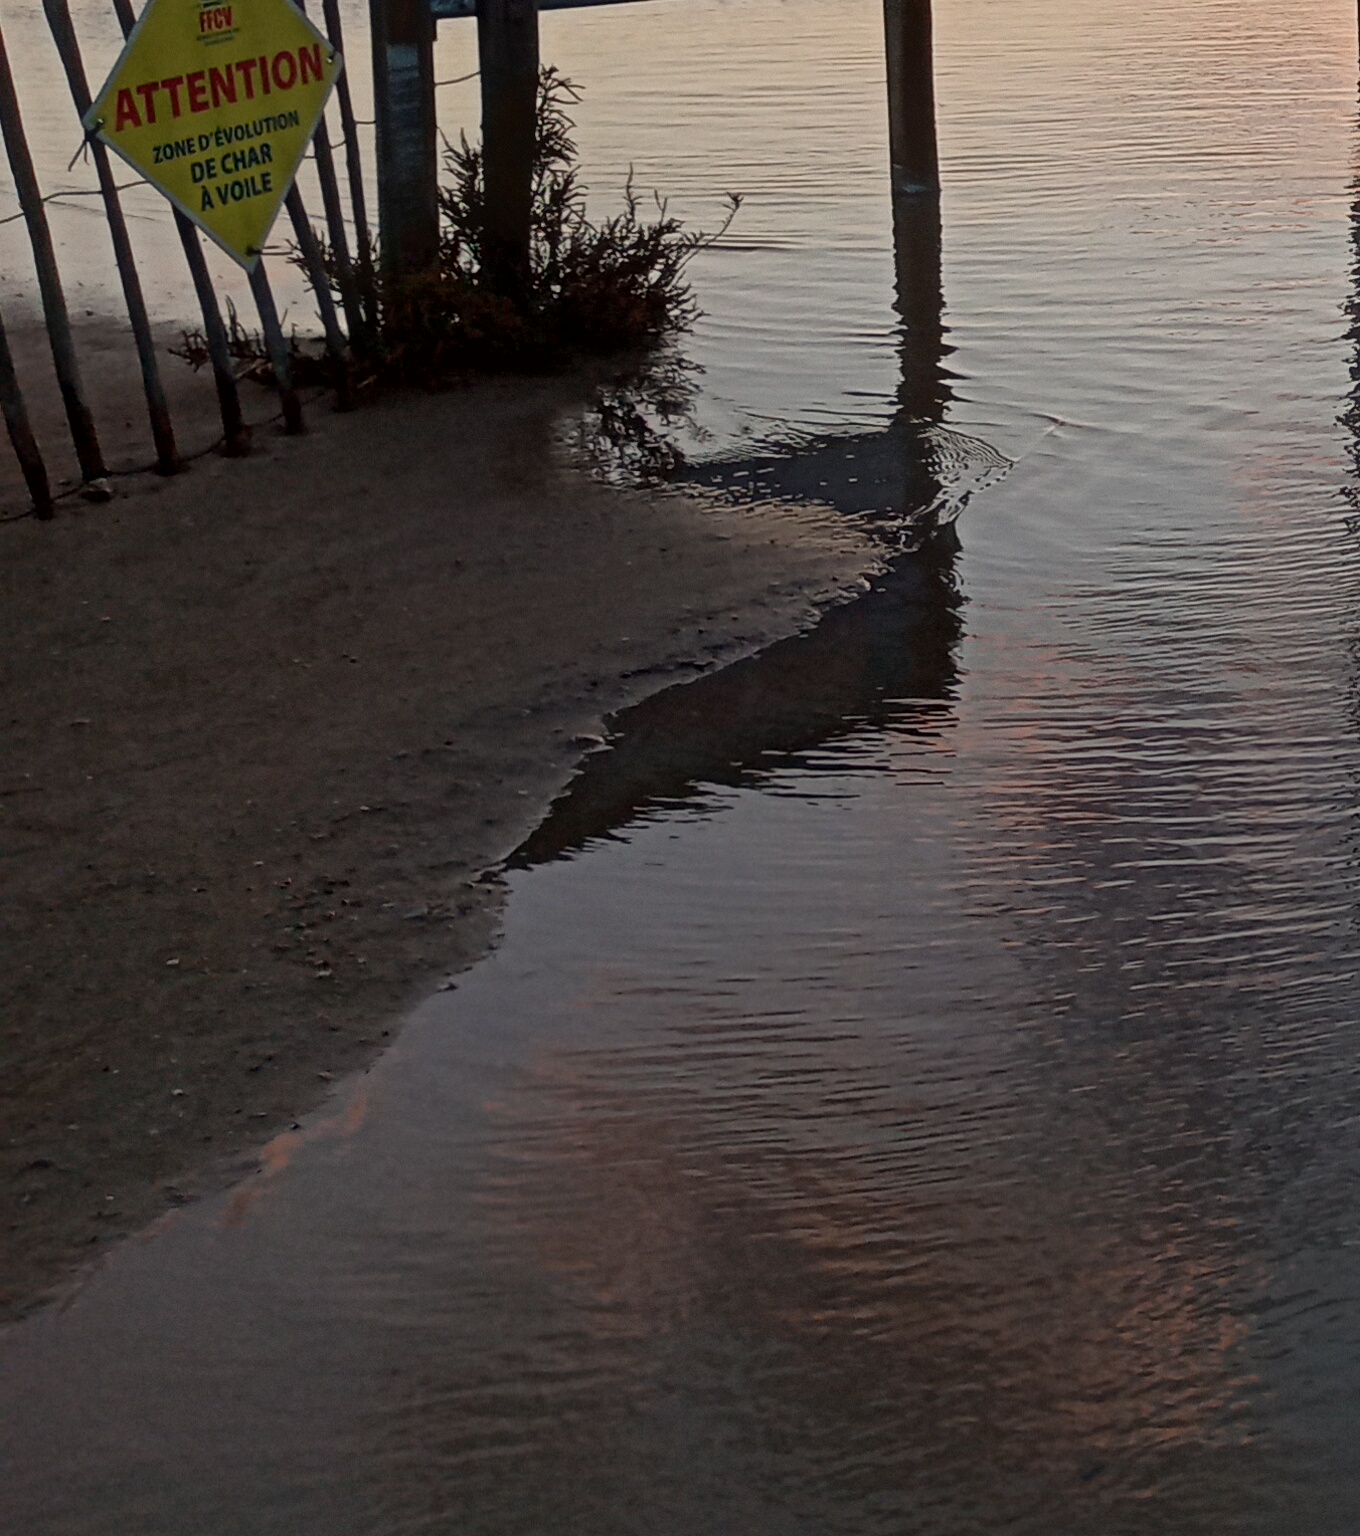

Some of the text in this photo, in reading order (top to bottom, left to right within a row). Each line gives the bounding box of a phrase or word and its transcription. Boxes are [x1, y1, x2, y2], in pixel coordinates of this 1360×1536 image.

[199, 6, 233, 33] FFCV
[115, 43, 323, 132] ATTENTION
[153, 110, 300, 164] ZONE D'ÉVOLUTION
[190, 143, 273, 183] DE CHAR
[200, 172, 273, 212] À VOILE
